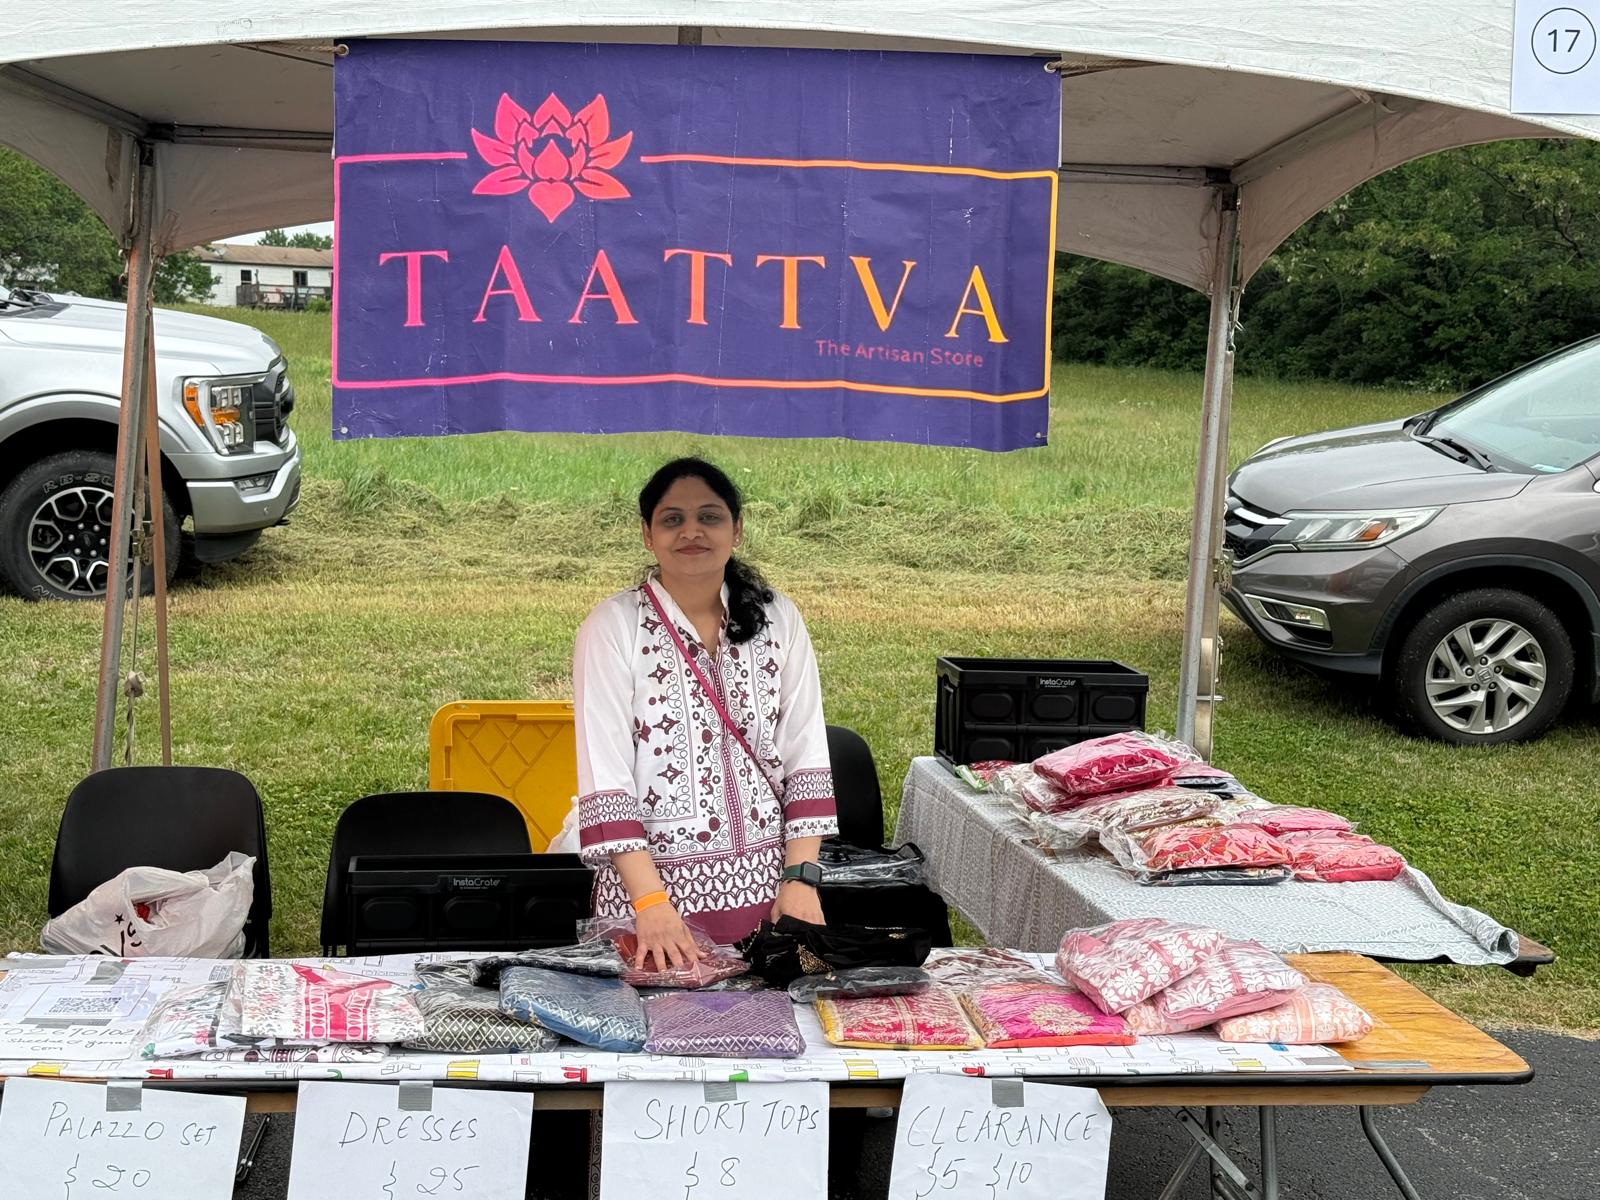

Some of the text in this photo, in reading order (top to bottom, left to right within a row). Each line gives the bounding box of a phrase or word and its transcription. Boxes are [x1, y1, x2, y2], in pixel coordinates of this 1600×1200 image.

[1547, 28, 1581, 53] 17
[379, 244, 1010, 343] TAATTVA
[815, 340, 984, 368] The Artisan Store
[44, 1101, 218, 1146] PALAZZO SET
[338, 1111, 478, 1149] DRESSES
[634, 1098, 820, 1140] SHORT TOPS
[907, 1105, 1099, 1148] CLEARANCE
